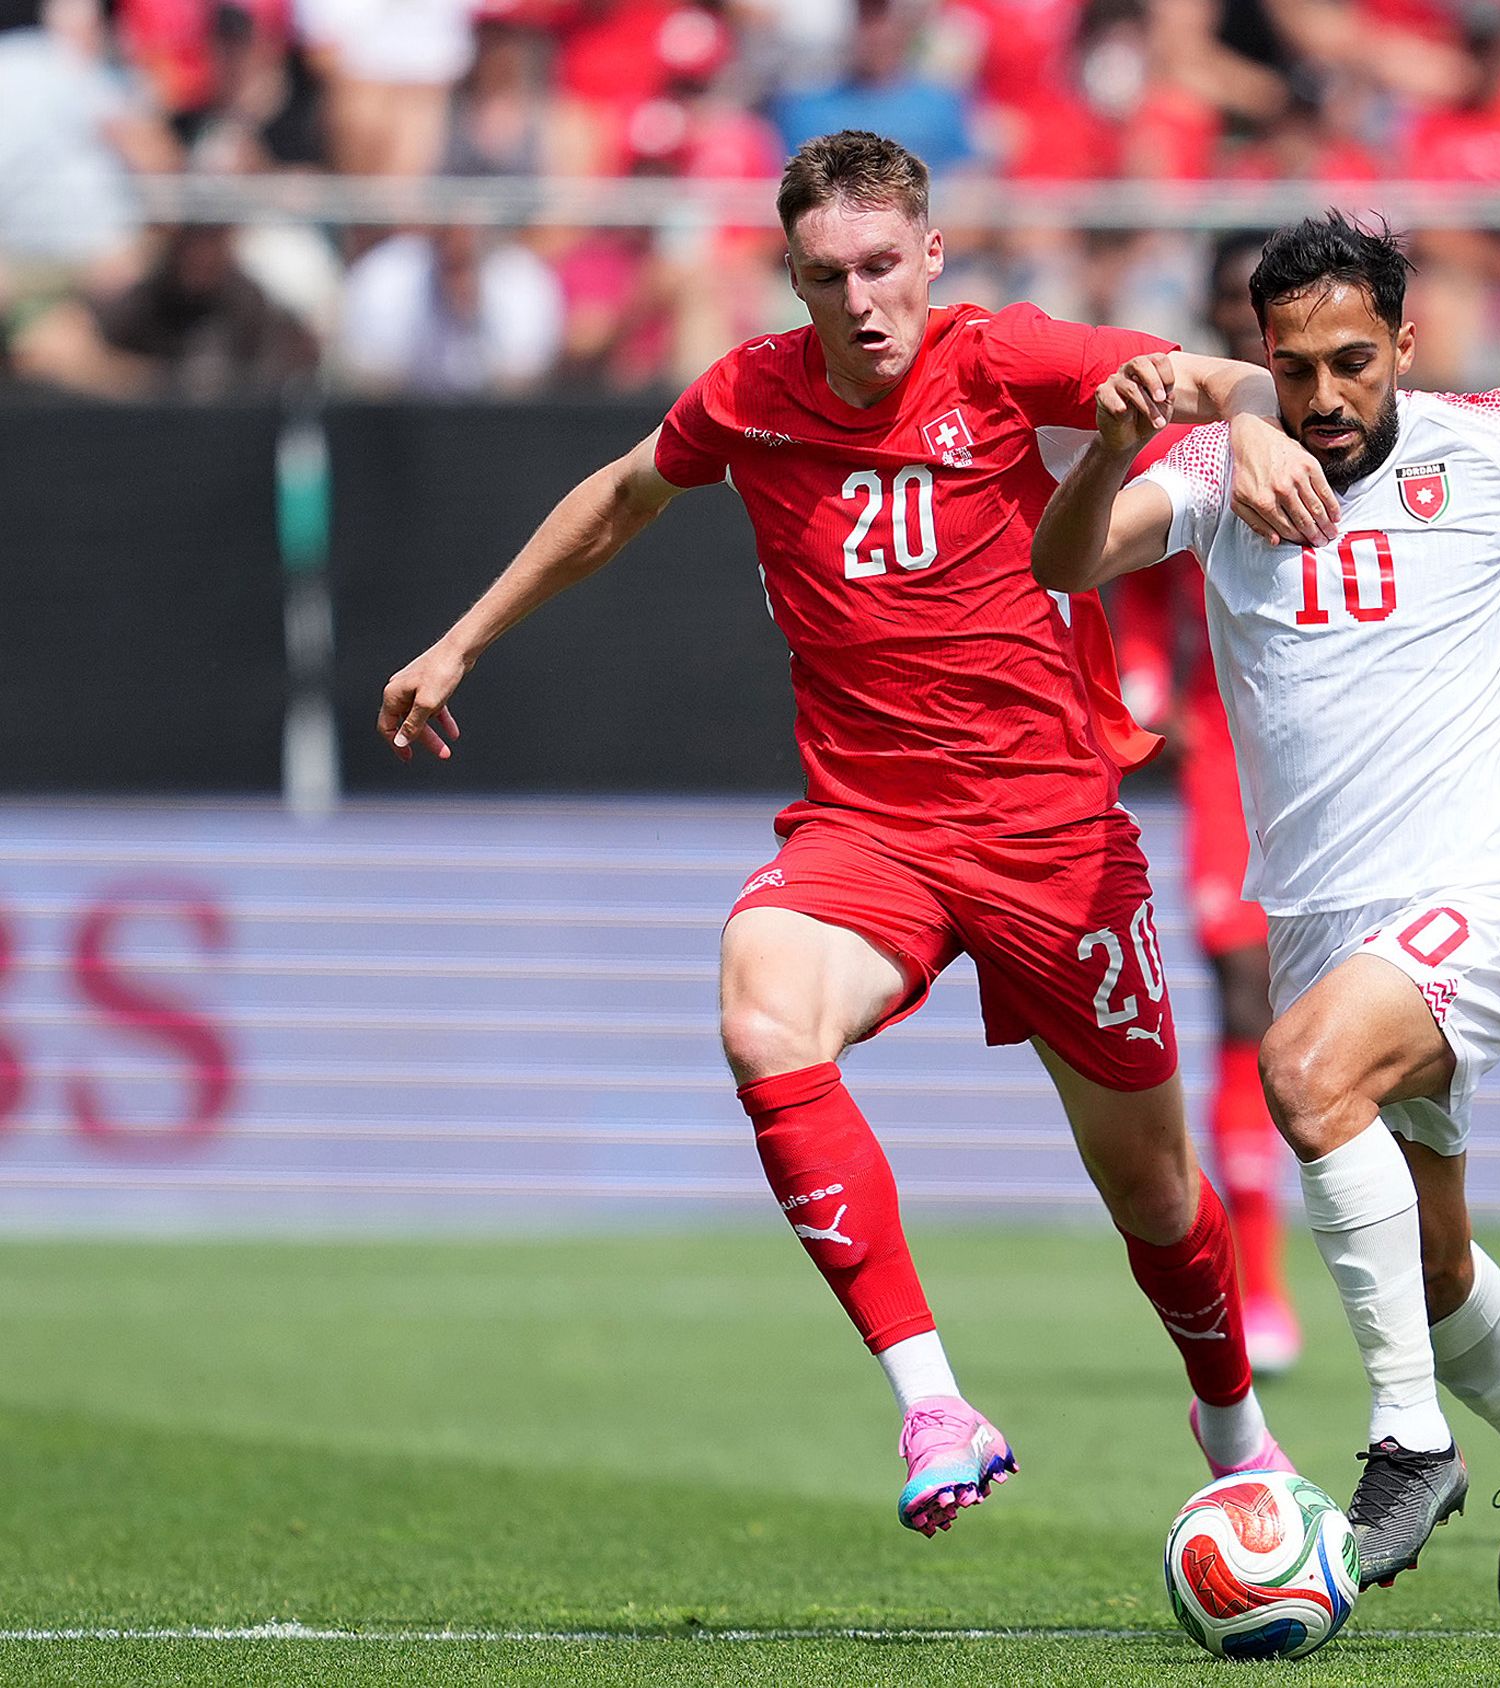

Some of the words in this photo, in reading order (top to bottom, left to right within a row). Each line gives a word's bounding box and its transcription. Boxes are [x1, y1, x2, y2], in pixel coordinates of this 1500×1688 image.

[841, 463, 938, 580] 20
[1401, 464, 1441, 477] JORDAN
[1295, 528, 1397, 626] 10
[1077, 899, 1165, 1029] 20
[1362, 906, 1470, 968] 0
[0, 872, 238, 1160] S
